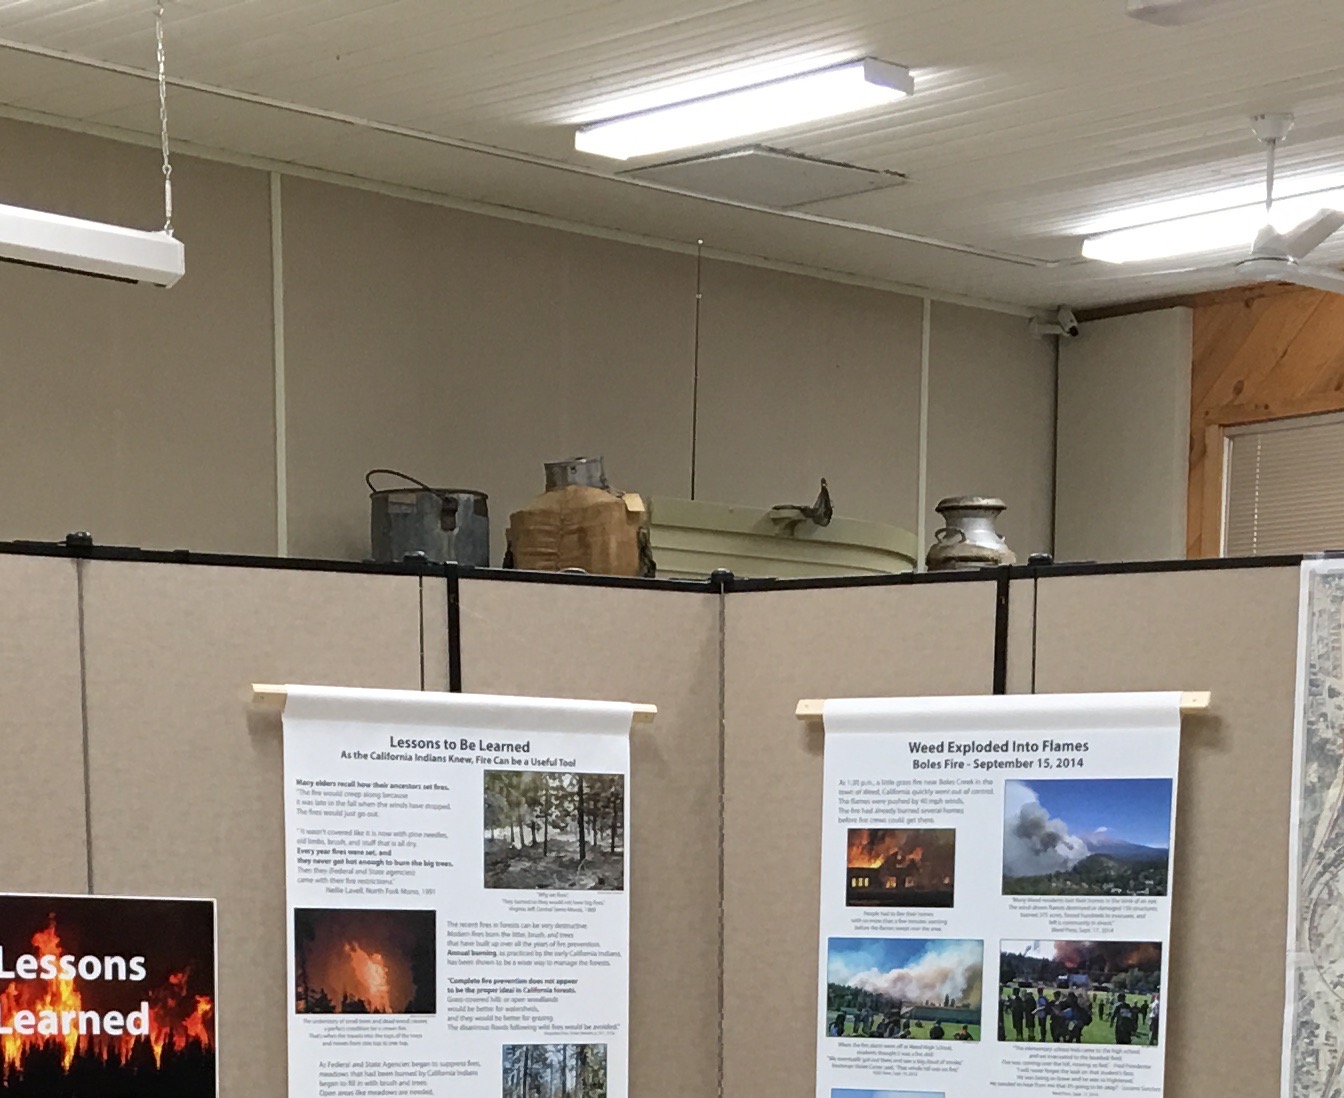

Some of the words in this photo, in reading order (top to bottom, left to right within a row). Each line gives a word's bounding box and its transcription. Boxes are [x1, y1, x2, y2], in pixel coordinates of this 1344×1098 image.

[390, 736, 441, 749] Lessons
[443, 739, 457, 750] to
[460, 738, 476, 751] Be
[479, 739, 530, 753] Learned
[908, 741, 944, 753] Weed
[948, 740, 1009, 756] Exploded
[1012, 740, 1039, 752] Into
[1042, 739, 1089, 752] Flames
[341, 750, 352, 759] As
[353, 750, 368, 760] the
[370, 751, 413, 761] California
[414, 753, 447, 763] Indians
[448, 755, 474, 764] Knew,
[475, 755, 492, 764] Fire
[493, 756, 510, 765] Can
[511, 756, 522, 766] be
[530, 757, 558, 766] Useful
[559, 758, 576, 767] Tool
[913, 759, 942, 770] Boles
[944, 759, 965, 769] Fire
[973, 758, 1034, 771] September
[1037, 758, 1053, 769] 15,
[1056, 758, 1084, 768] 2014
